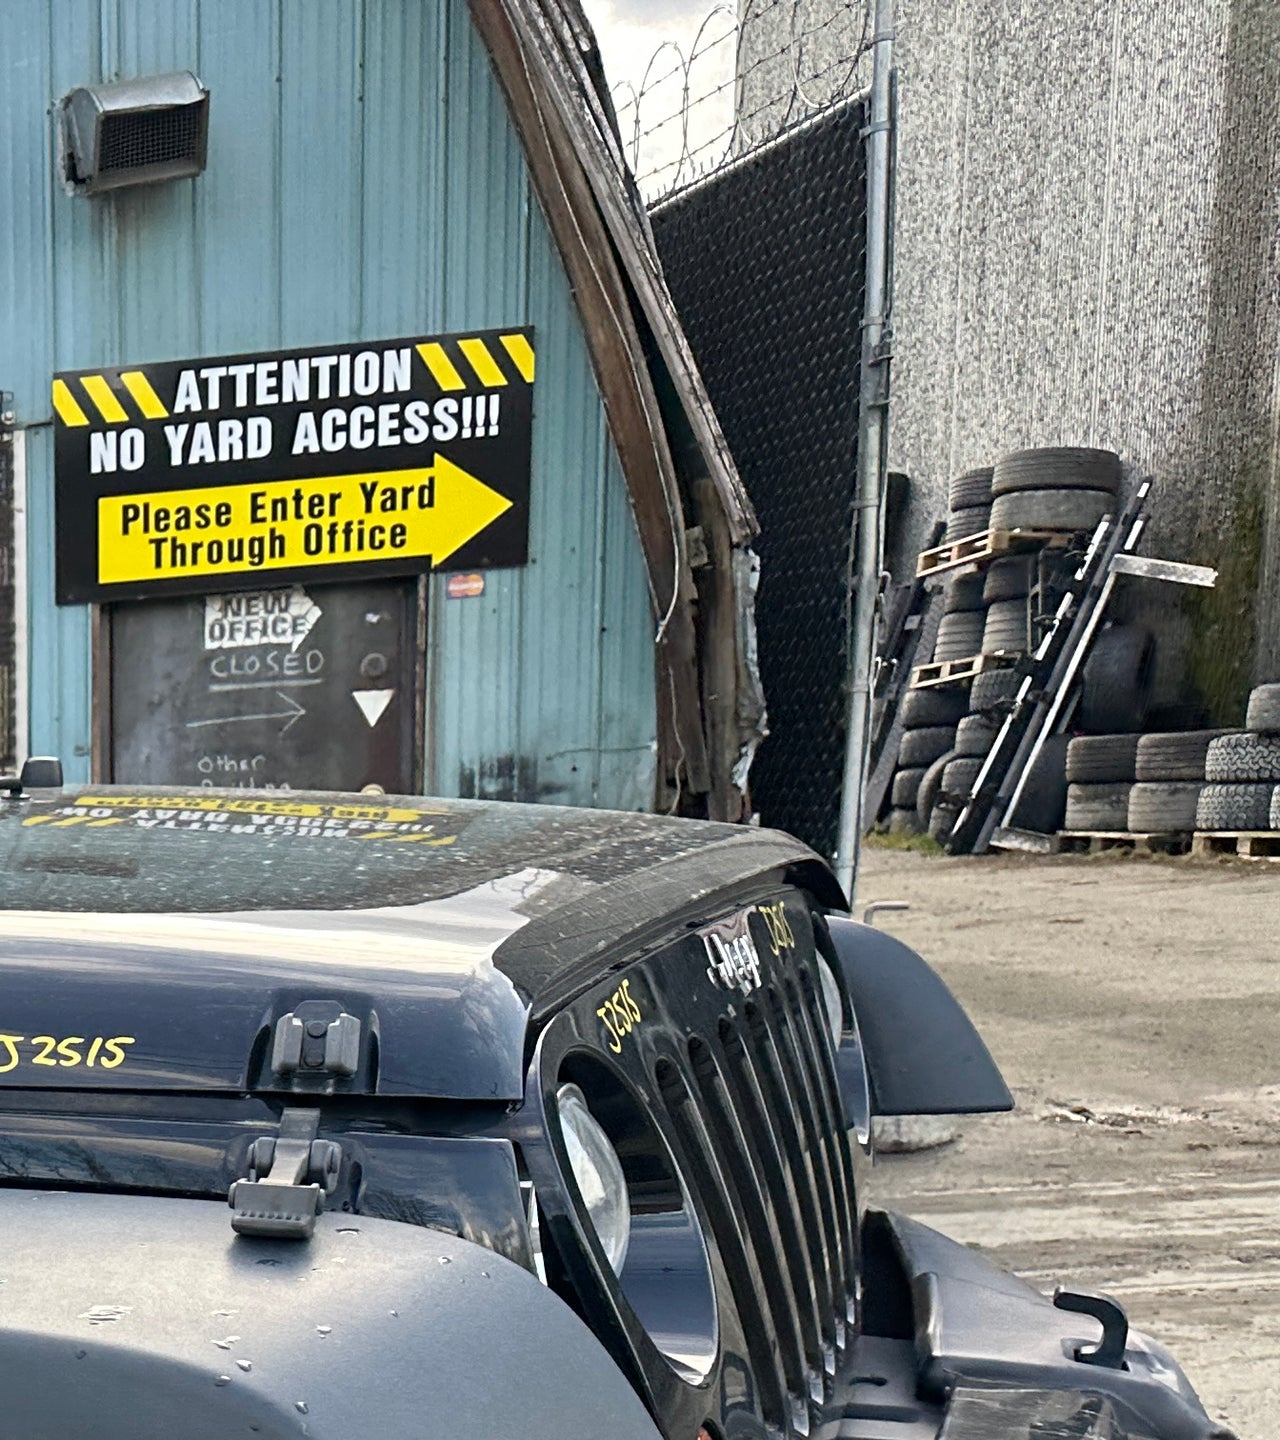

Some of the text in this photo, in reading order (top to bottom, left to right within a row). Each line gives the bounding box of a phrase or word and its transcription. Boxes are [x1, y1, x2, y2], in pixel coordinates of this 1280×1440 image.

[173, 348, 413, 413] ATTENTION
[89, 394, 500, 474] NO YARD ACCESS!!!
[121, 476, 435, 536] Please Enter Yard
[149, 518, 407, 569] Through Office
[209, 615, 310, 642] OFFICE
[224, 594, 290, 616] NEW
[210, 649, 324, 678] CLOSED
[596, 978, 642, 1054] J2515
